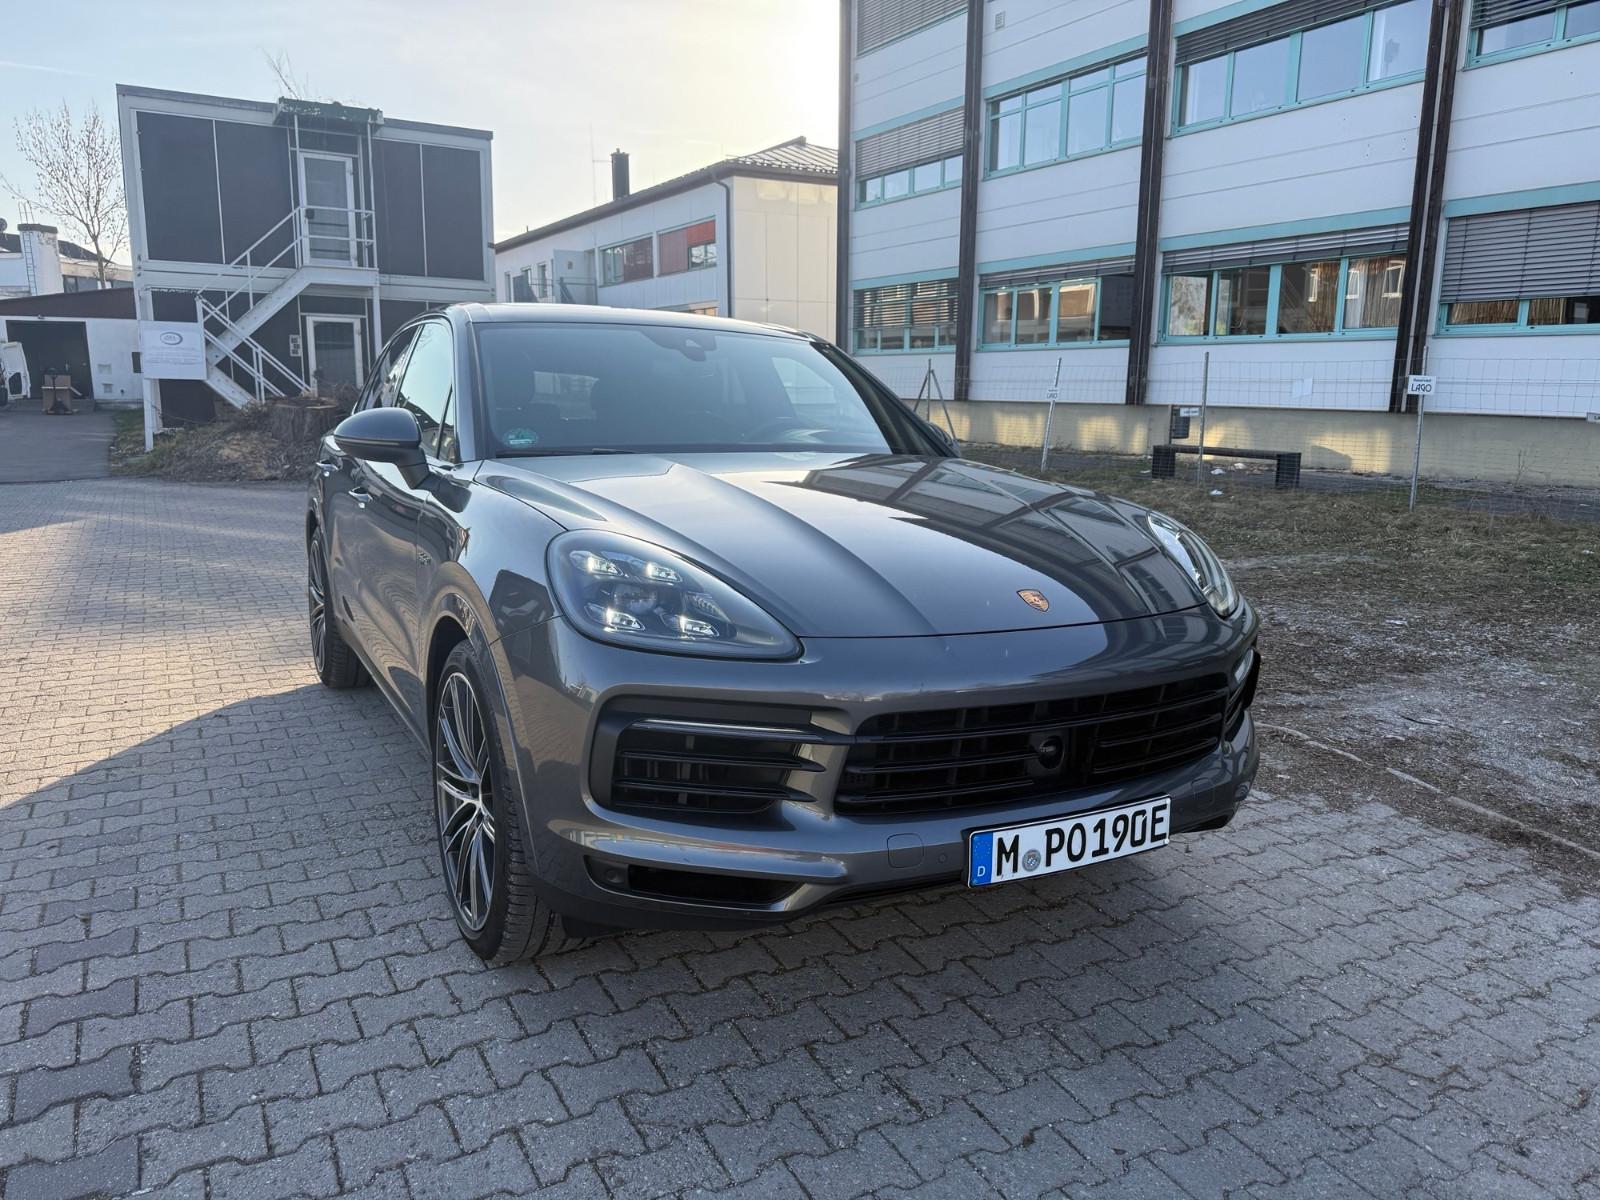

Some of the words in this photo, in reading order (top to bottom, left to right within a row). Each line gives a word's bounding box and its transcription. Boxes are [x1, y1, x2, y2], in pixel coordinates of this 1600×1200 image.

[1411, 383, 1432, 392] LAGO
[996, 834, 1020, 876] M
[977, 866, 986, 877] D
